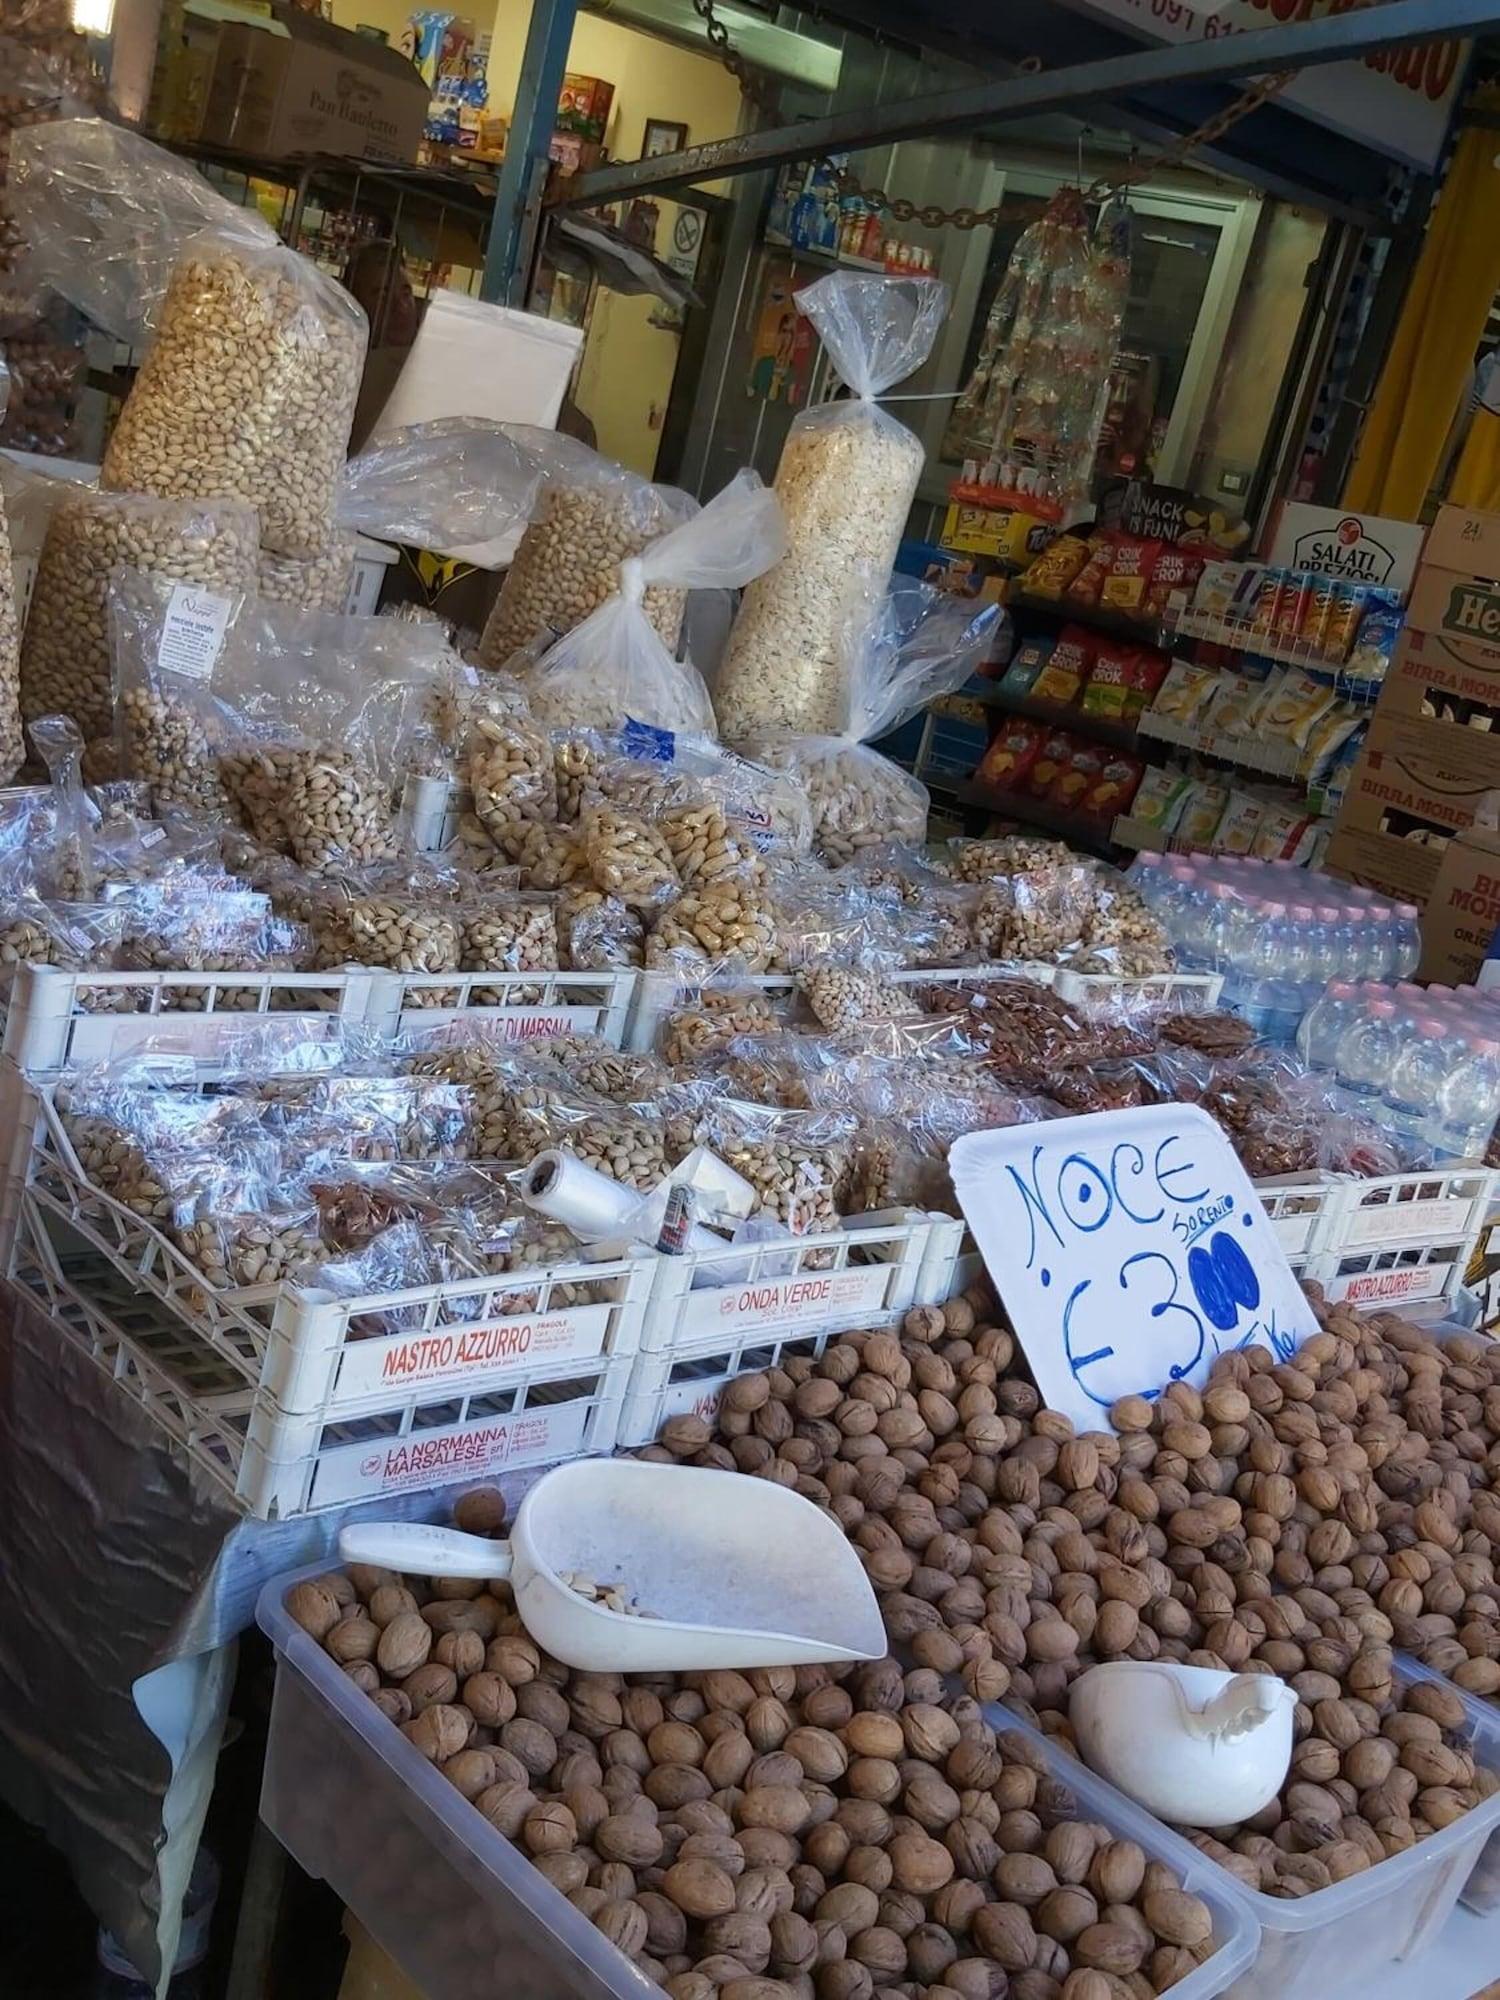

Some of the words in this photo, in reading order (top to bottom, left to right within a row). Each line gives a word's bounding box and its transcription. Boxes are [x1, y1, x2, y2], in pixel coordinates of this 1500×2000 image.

[1130, 498, 1185, 523] SNACK
[1311, 542, 1376, 571] SALATI
[1402, 660, 1457, 688] BIRRA
[1360, 778, 1413, 807] BIRRA
[518, 1017, 573, 1041] MARSALA
[1004, 1136, 1210, 1270] NOCE
[738, 1288, 779, 1312] ONDA
[782, 1279, 833, 1305] VERDE
[1346, 1276, 1377, 1300] NASTRO
[1378, 1272, 1413, 1295] AZZURRO
[382, 1335, 453, 1377] NASTRO
[453, 1325, 532, 1364] AZZURRO
[387, 1448, 408, 1464] LA
[411, 1426, 508, 1457] NORMANNA
[383, 1445, 487, 1478] MARSALESE
